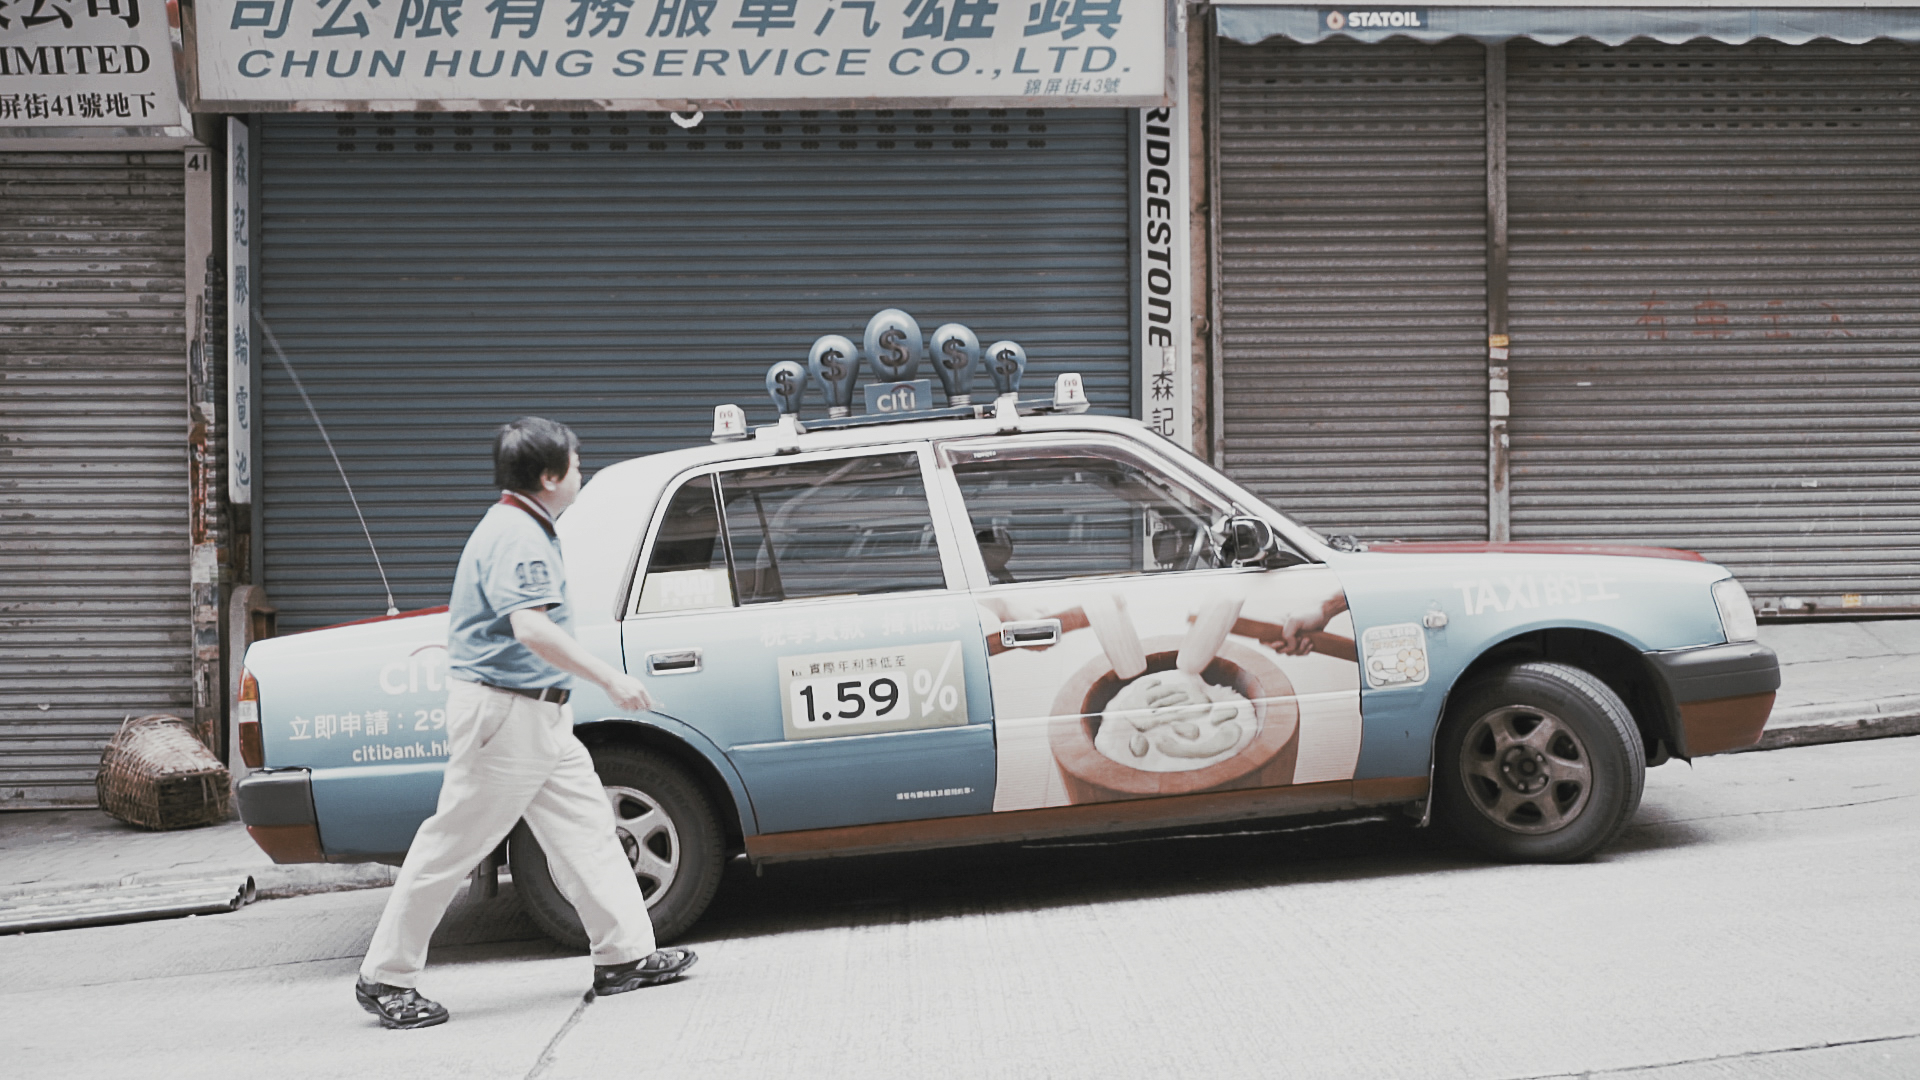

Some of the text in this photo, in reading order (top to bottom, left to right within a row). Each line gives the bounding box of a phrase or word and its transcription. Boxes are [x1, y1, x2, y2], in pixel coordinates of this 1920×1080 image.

[0, 0, 140, 29] 公司
[1348, 11, 1421, 27] STATOIL
[0, 45, 150, 75] IMITED
[237, 49, 405, 78] CHUN
[424, 50, 593, 77] HUNG
[612, 48, 870, 77] SERVICE
[1023, 78, 1121, 95] 錦屏街43號
[188, 154, 207, 171] 41
[1146, 107, 1172, 347] RIDGESTONE
[877, 388, 916, 413] citi
[1152, 372, 1174, 437] 森記
[1453, 569, 1620, 616] TAXI 的士
[380, 653, 446, 695] cit
[800, 678, 899, 721] 1.59
[414, 709, 446, 731] 29
[352, 739, 450, 762] citibank.hk
